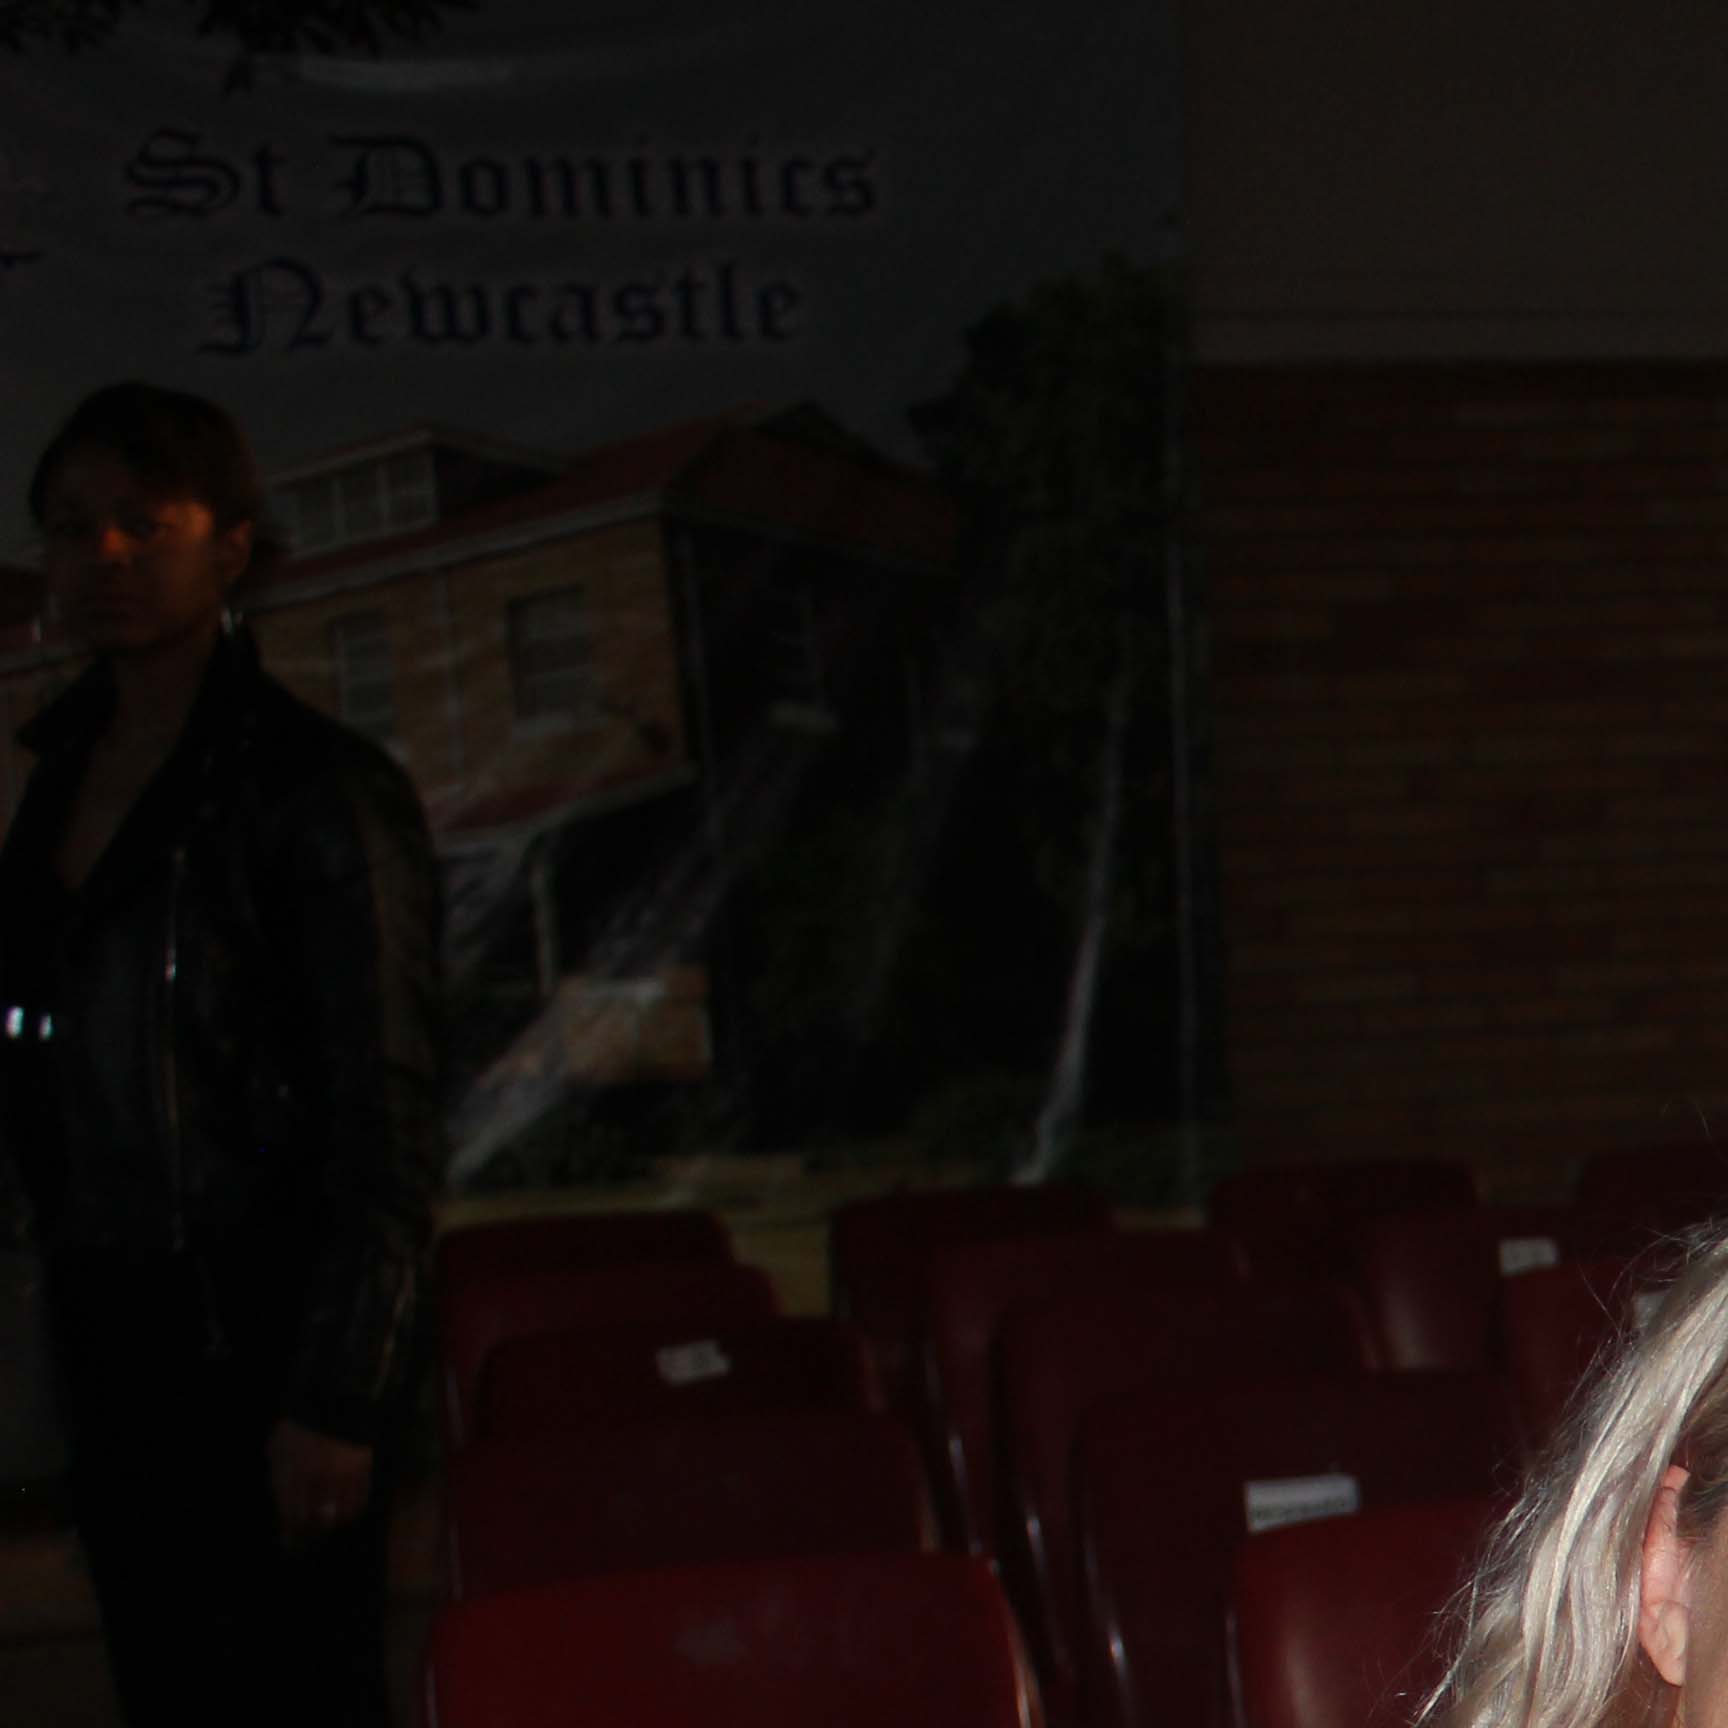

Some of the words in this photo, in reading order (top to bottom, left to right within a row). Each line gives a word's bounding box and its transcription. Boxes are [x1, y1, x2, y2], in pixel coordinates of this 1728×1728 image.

[124, 128, 284, 218] St
[328, 133, 879, 220] Dominics
[197, 256, 804, 357] Newcastle
